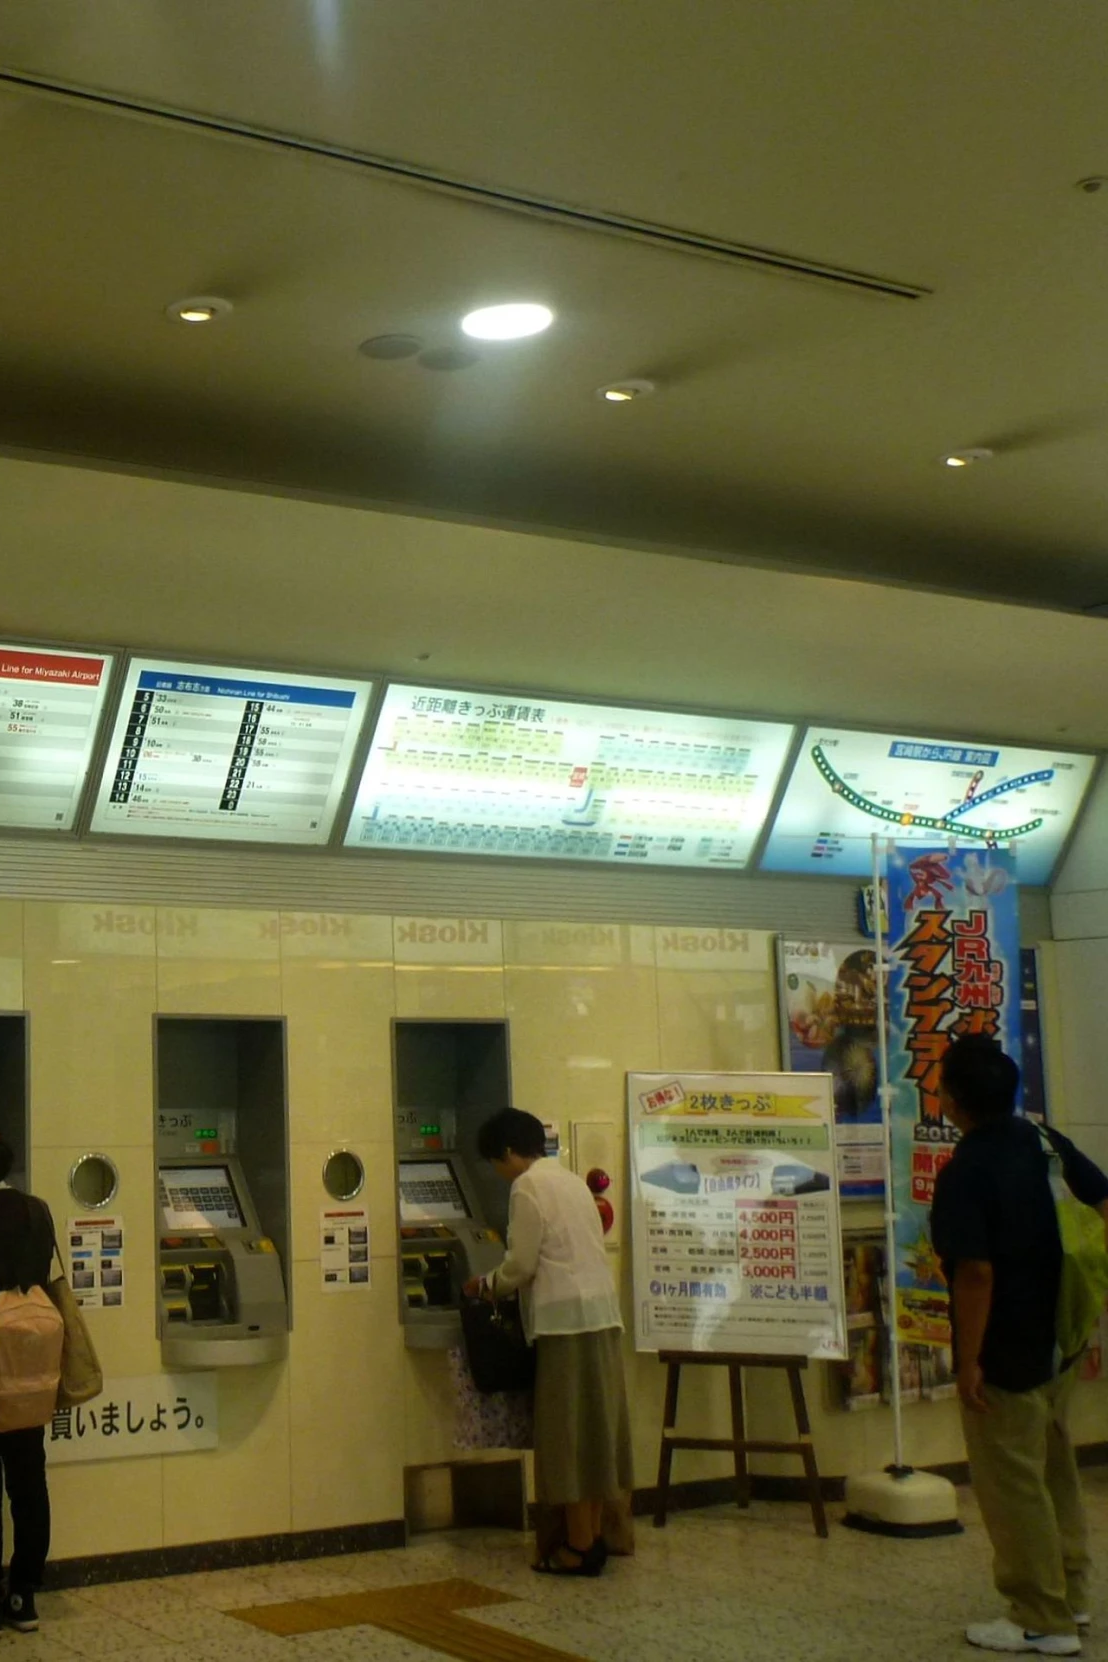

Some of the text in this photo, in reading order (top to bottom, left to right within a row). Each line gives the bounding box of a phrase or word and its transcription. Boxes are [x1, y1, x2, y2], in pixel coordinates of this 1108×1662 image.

[2, 665, 19, 674] Line
[35, 667, 70, 678] Miyazaki
[71, 670, 100, 680] Airport
[10, 712, 20, 720] 51
[124, 760, 132, 768] 11
[120, 771, 130, 780] 12
[690, 1094, 771, 1111] 2枚きっぷ
[915, 1125, 964, 1142] 2013
[740, 1229, 795, 1242] 4,000円
[741, 1247, 795, 1260] 2,500円
[50, 1398, 204, 1441] 買いましょう。
